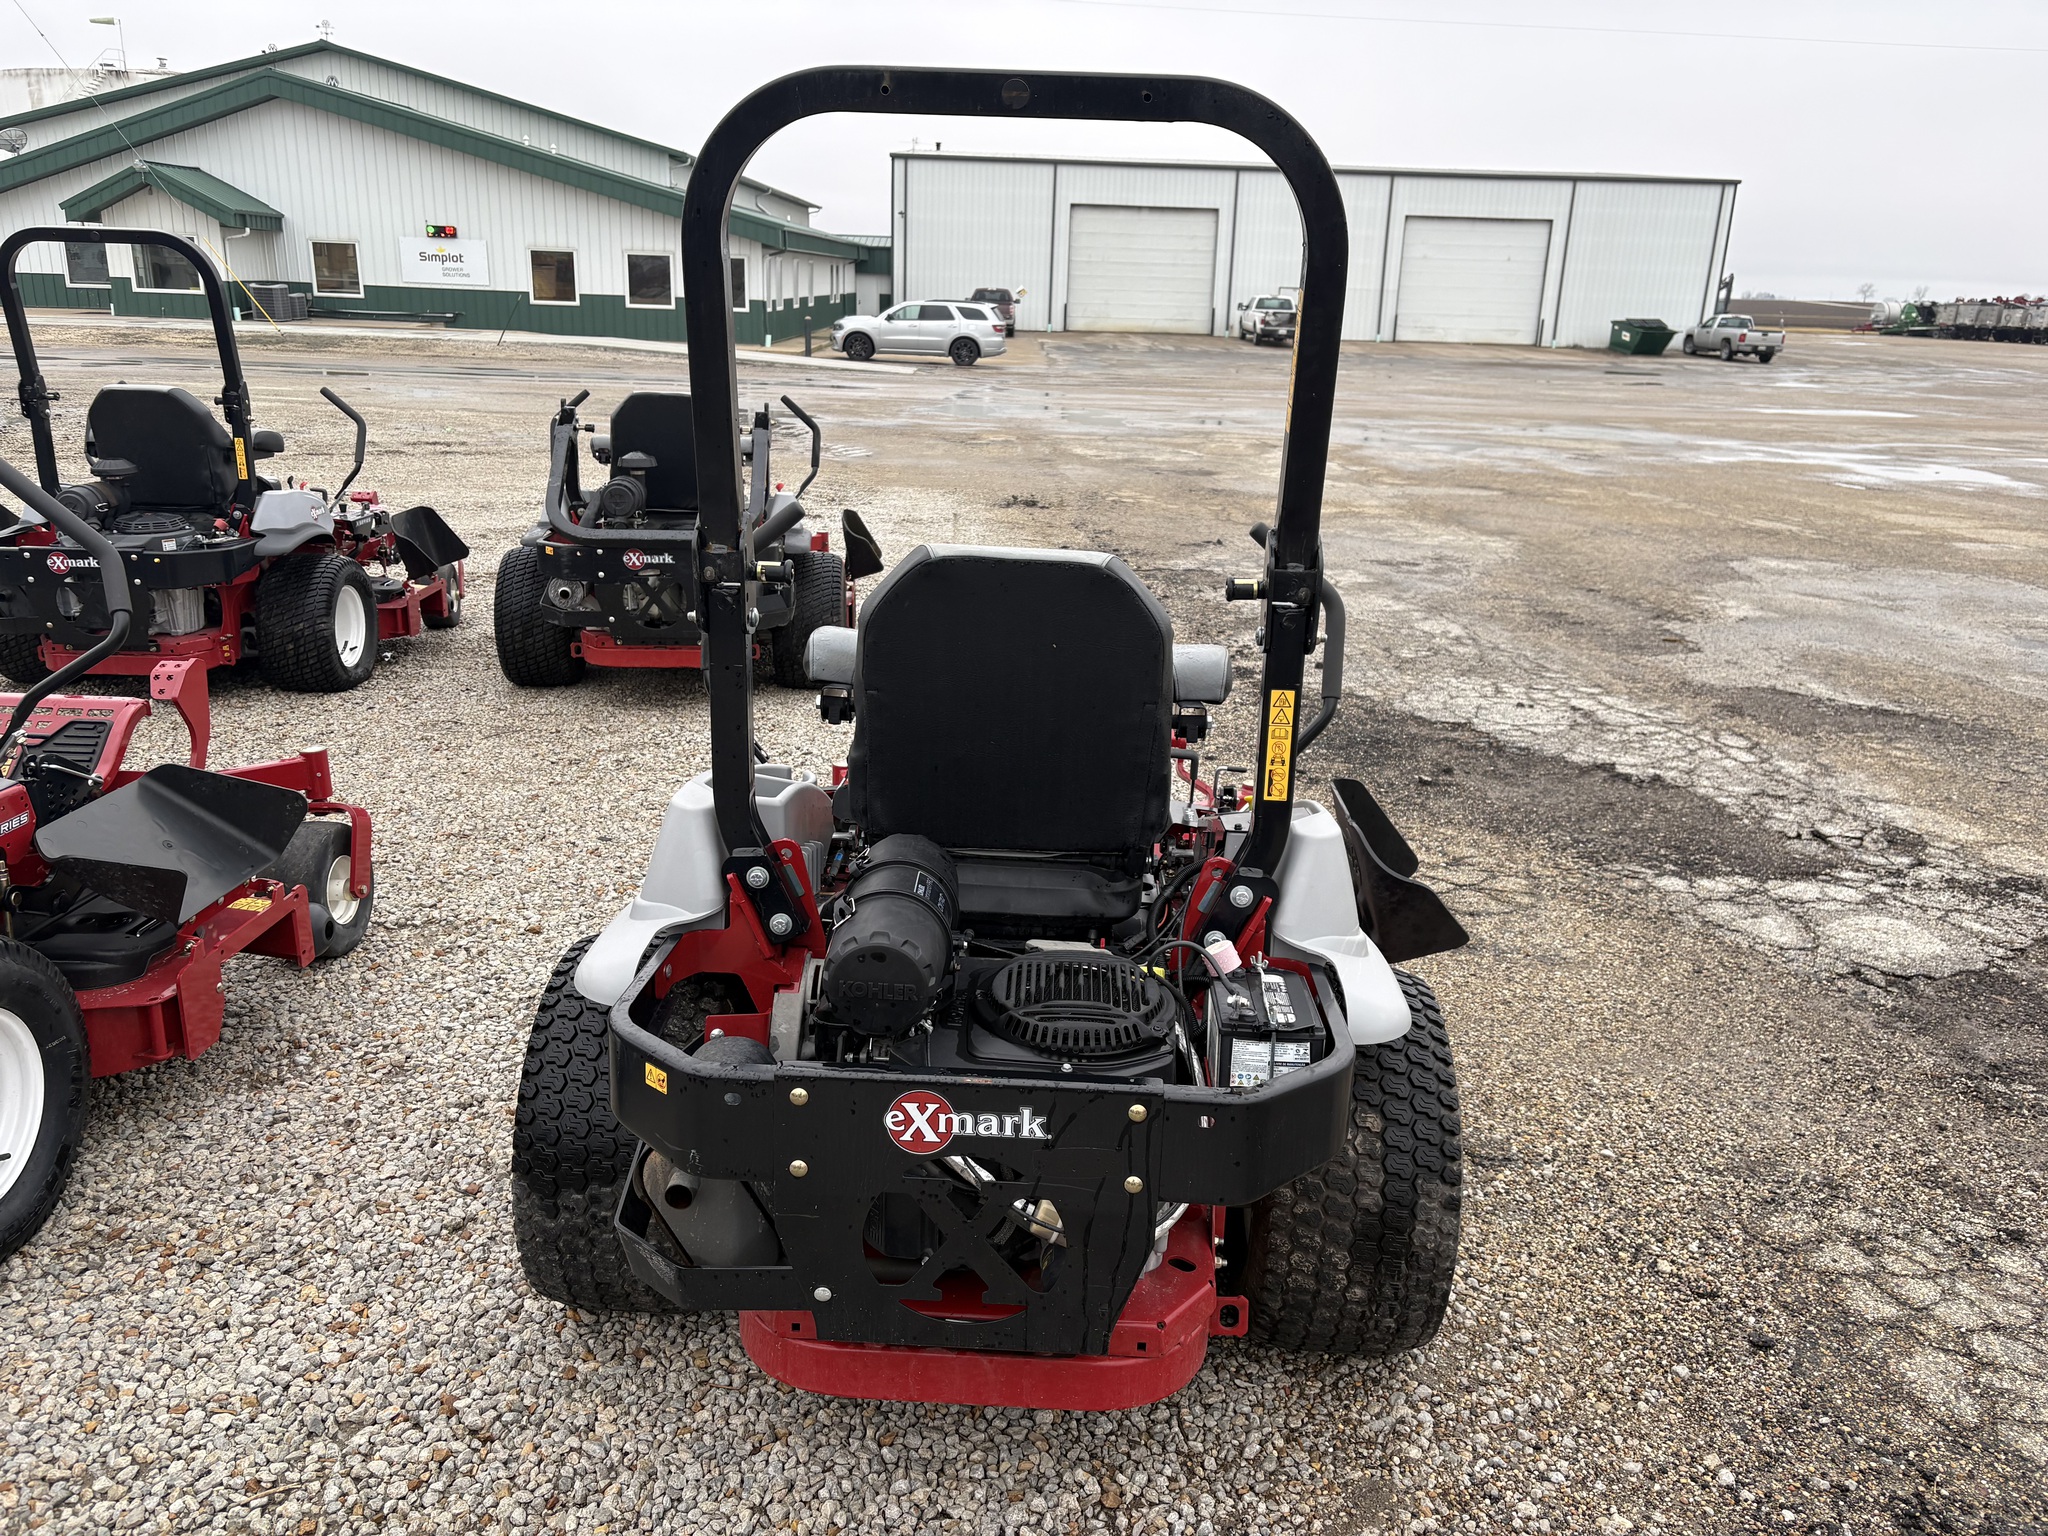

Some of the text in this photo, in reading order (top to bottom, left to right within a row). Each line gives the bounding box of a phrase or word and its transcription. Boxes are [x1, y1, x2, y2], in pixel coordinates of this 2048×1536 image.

[419, 251, 464, 265] Simplot
[46, 555, 101, 570] eXmark
[623, 552, 675, 566] eXmark
[838, 980, 919, 1002] KOHLER
[885, 1101, 1051, 1144] eXmark
